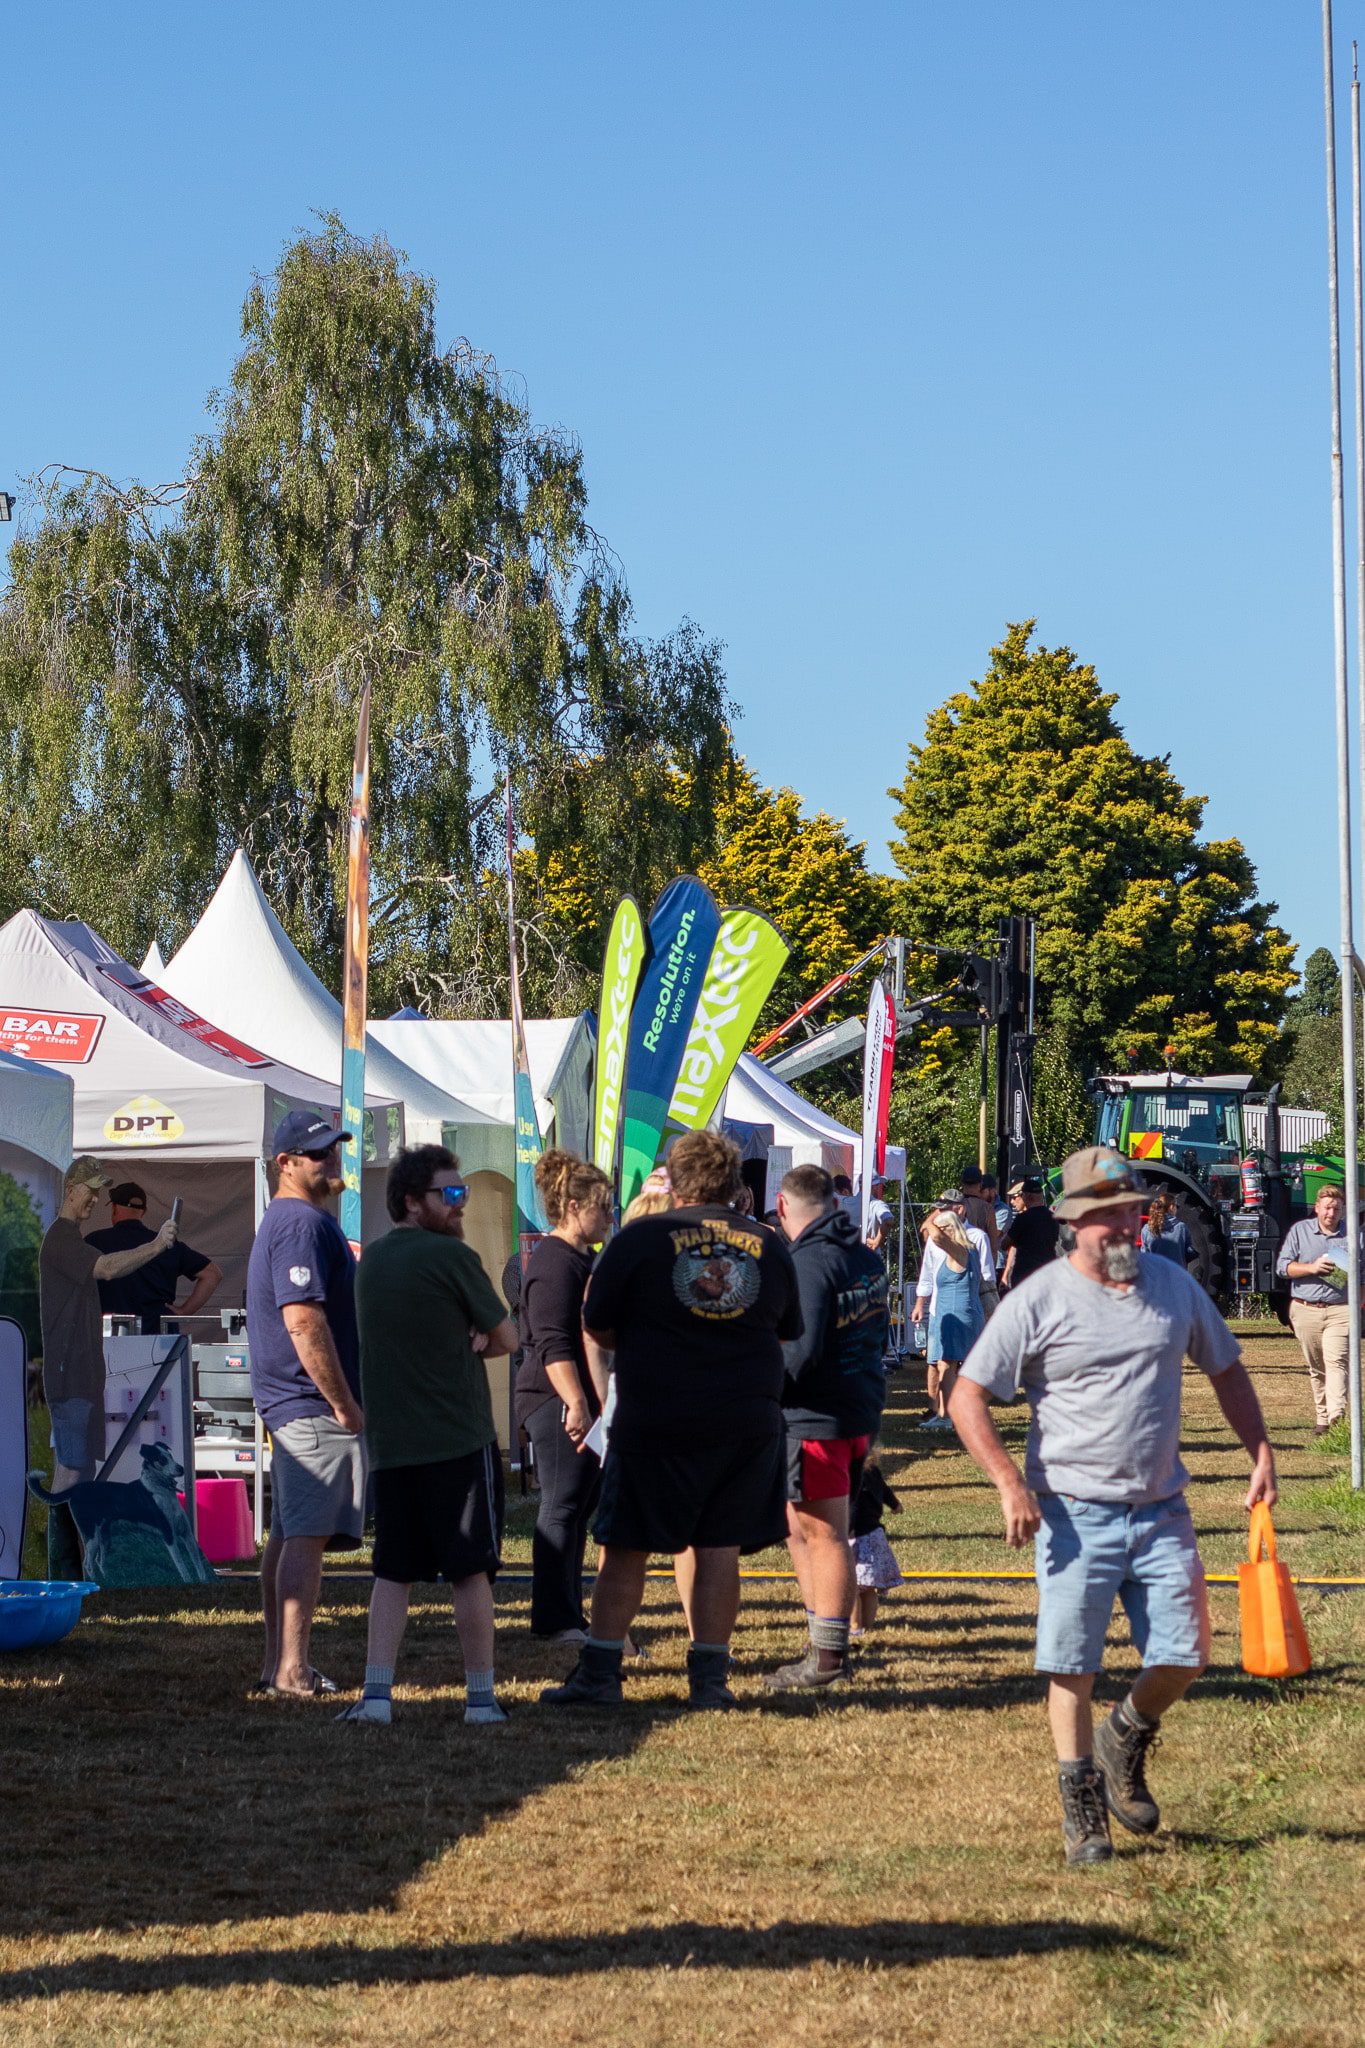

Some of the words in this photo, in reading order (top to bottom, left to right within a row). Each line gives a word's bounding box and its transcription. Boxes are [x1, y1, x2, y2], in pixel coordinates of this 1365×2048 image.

[686, 951, 696, 964] it
[642, 909, 696, 1053] Resolution.
[682, 966, 692, 985] on
[669, 989, 685, 1024] We're
[2, 1016, 81, 1037] BAR
[24, 1033, 43, 1042] for
[45, 1036, 78, 1046] them
[656, 923, 758, 1162] maXtec
[113, 1116, 175, 1132] DPT
[669, 1228, 713, 1256] MAD
